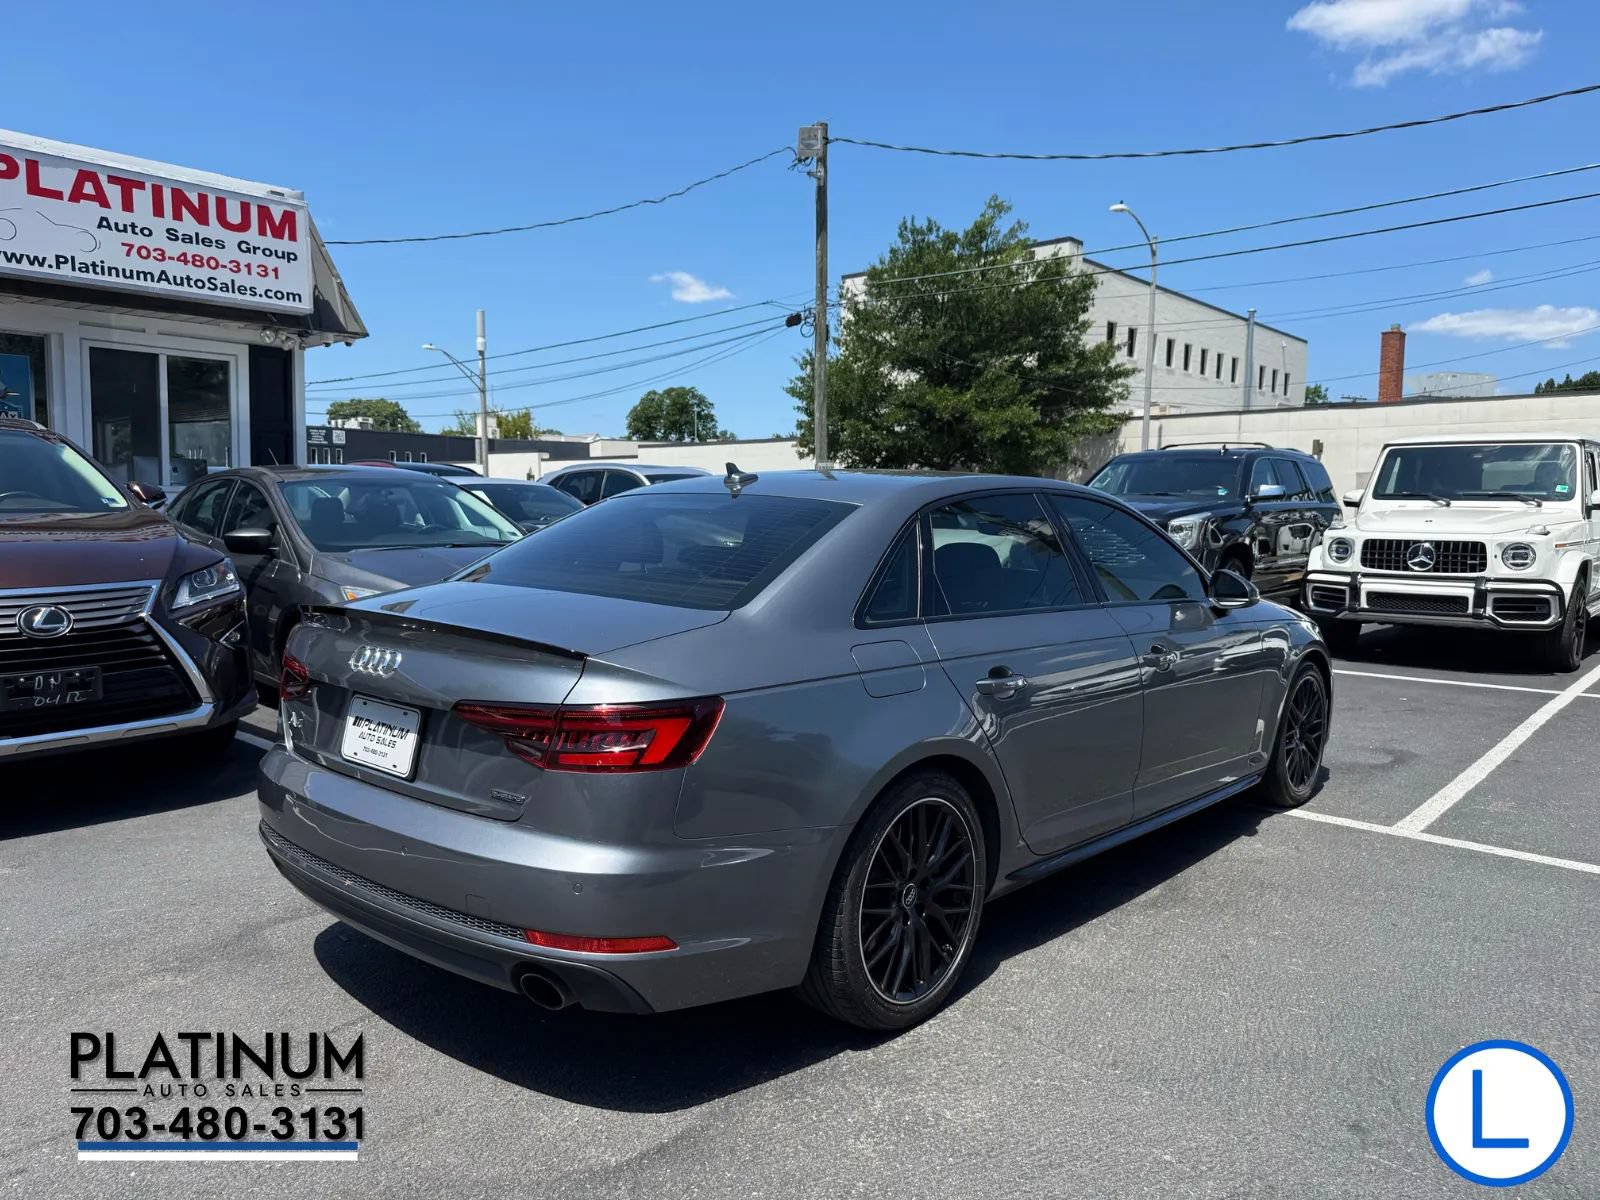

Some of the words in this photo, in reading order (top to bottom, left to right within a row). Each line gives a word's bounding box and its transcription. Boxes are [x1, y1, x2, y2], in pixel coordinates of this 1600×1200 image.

[0, 153, 298, 242] PLATINUM
[97, 215, 154, 238] Auto
[166, 227, 226, 250] Sales
[237, 240, 298, 264] Group
[121, 242, 280, 281] 703-480-3131
[358, 731, 376, 743] AUTO
[375, 736, 397, 749] SALES
[361, 718, 410, 741] PLATINUM
